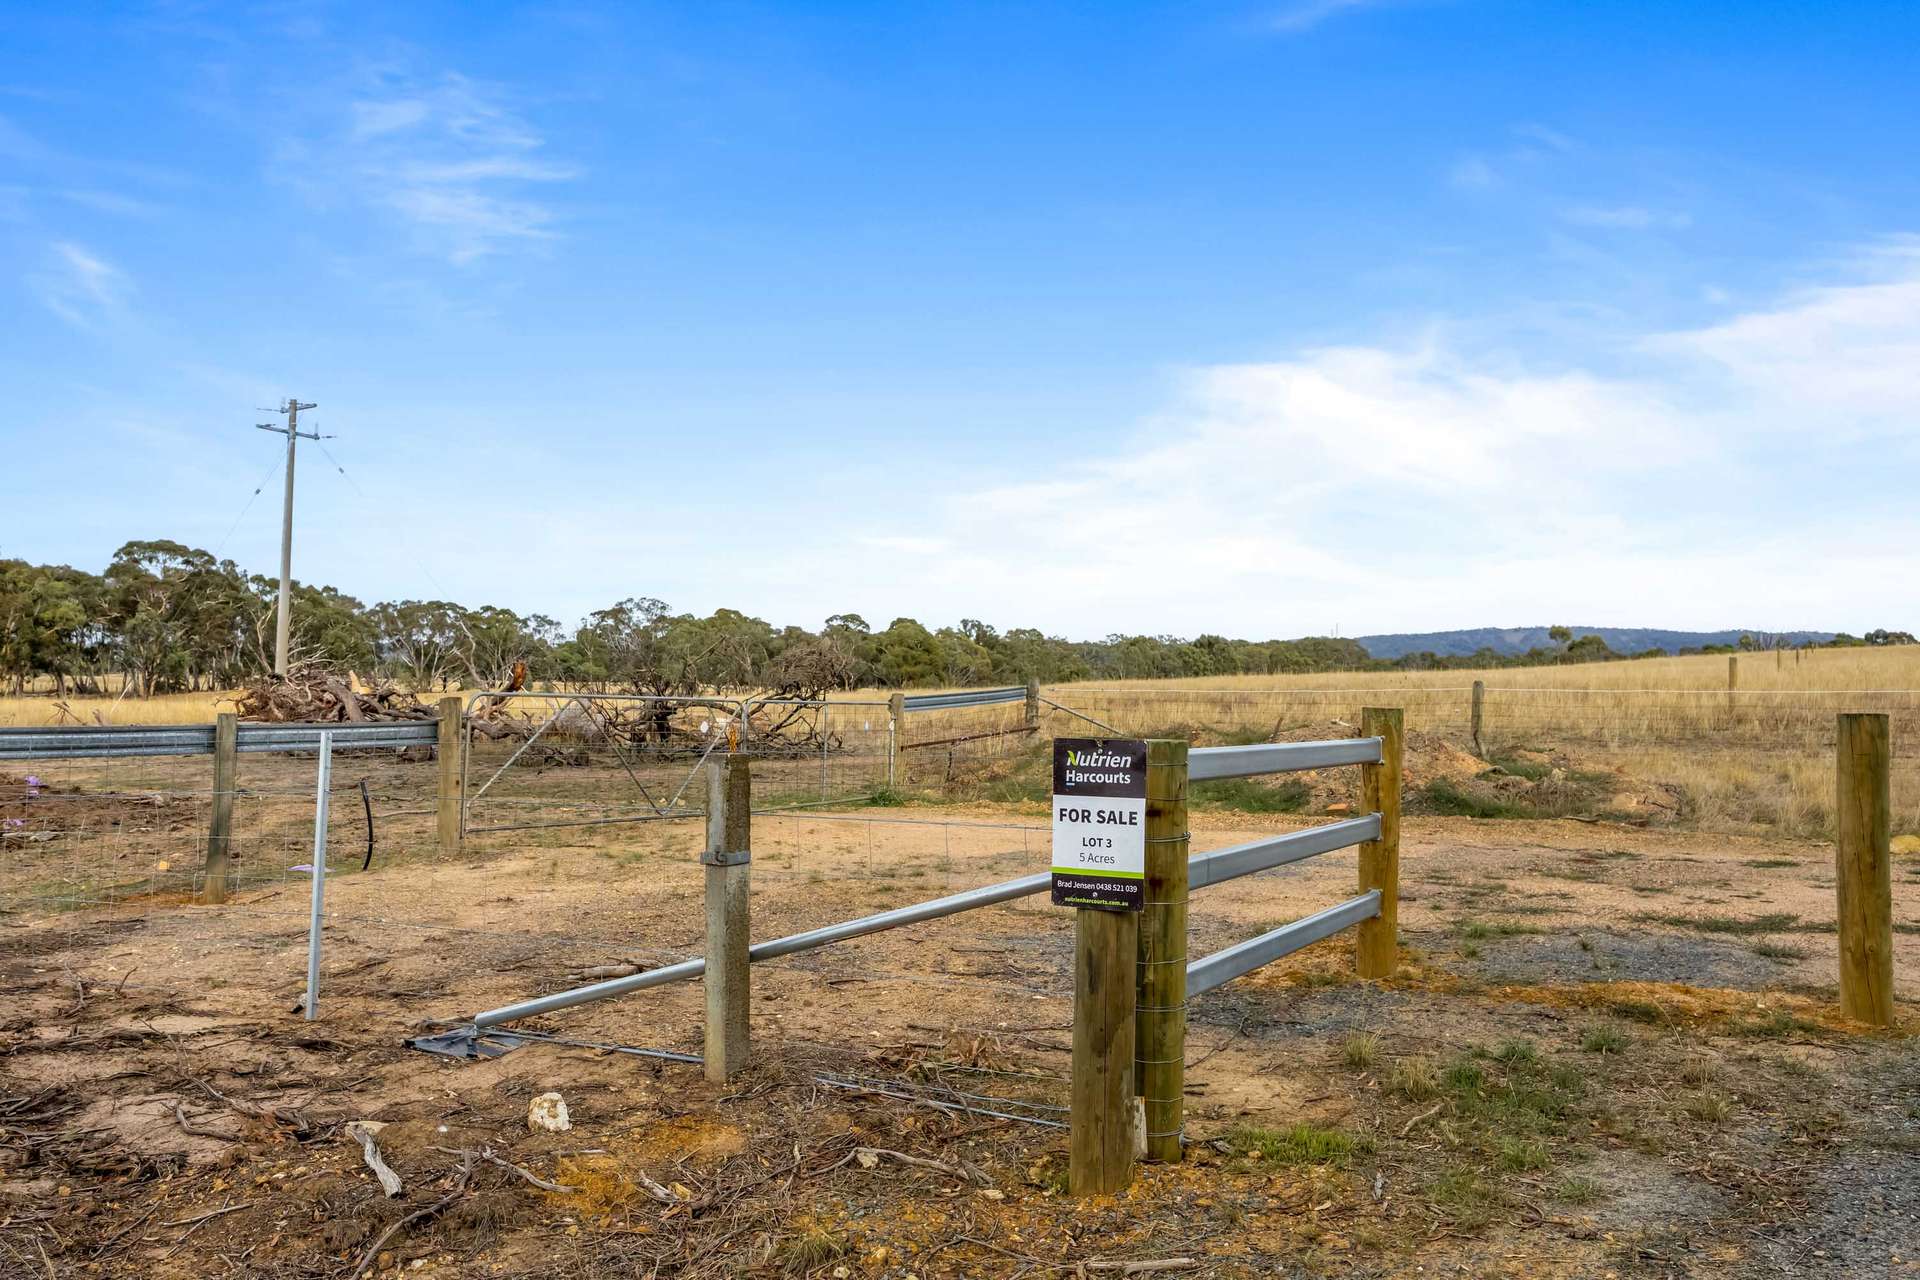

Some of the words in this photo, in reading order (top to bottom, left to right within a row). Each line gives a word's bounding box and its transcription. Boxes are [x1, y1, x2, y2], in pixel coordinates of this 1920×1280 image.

[1066, 750, 1132, 768] Nutrien
[1066, 769, 1131, 784] Harcourts
[1059, 808, 1092, 823] FOR
[1096, 809, 1138, 826] SALE
[1082, 837, 1103, 848] LOT
[1106, 838, 1112, 848] 3
[1079, 852, 1086, 862] 5
[1087, 852, 1115, 864] Acres
[1057, 880, 1072, 888] Brad
[1073, 881, 1095, 890] Jensen
[1096, 883, 1112, 891] 0438
[1112, 884, 1124, 892] 521
[1125, 885, 1138, 893] 039
